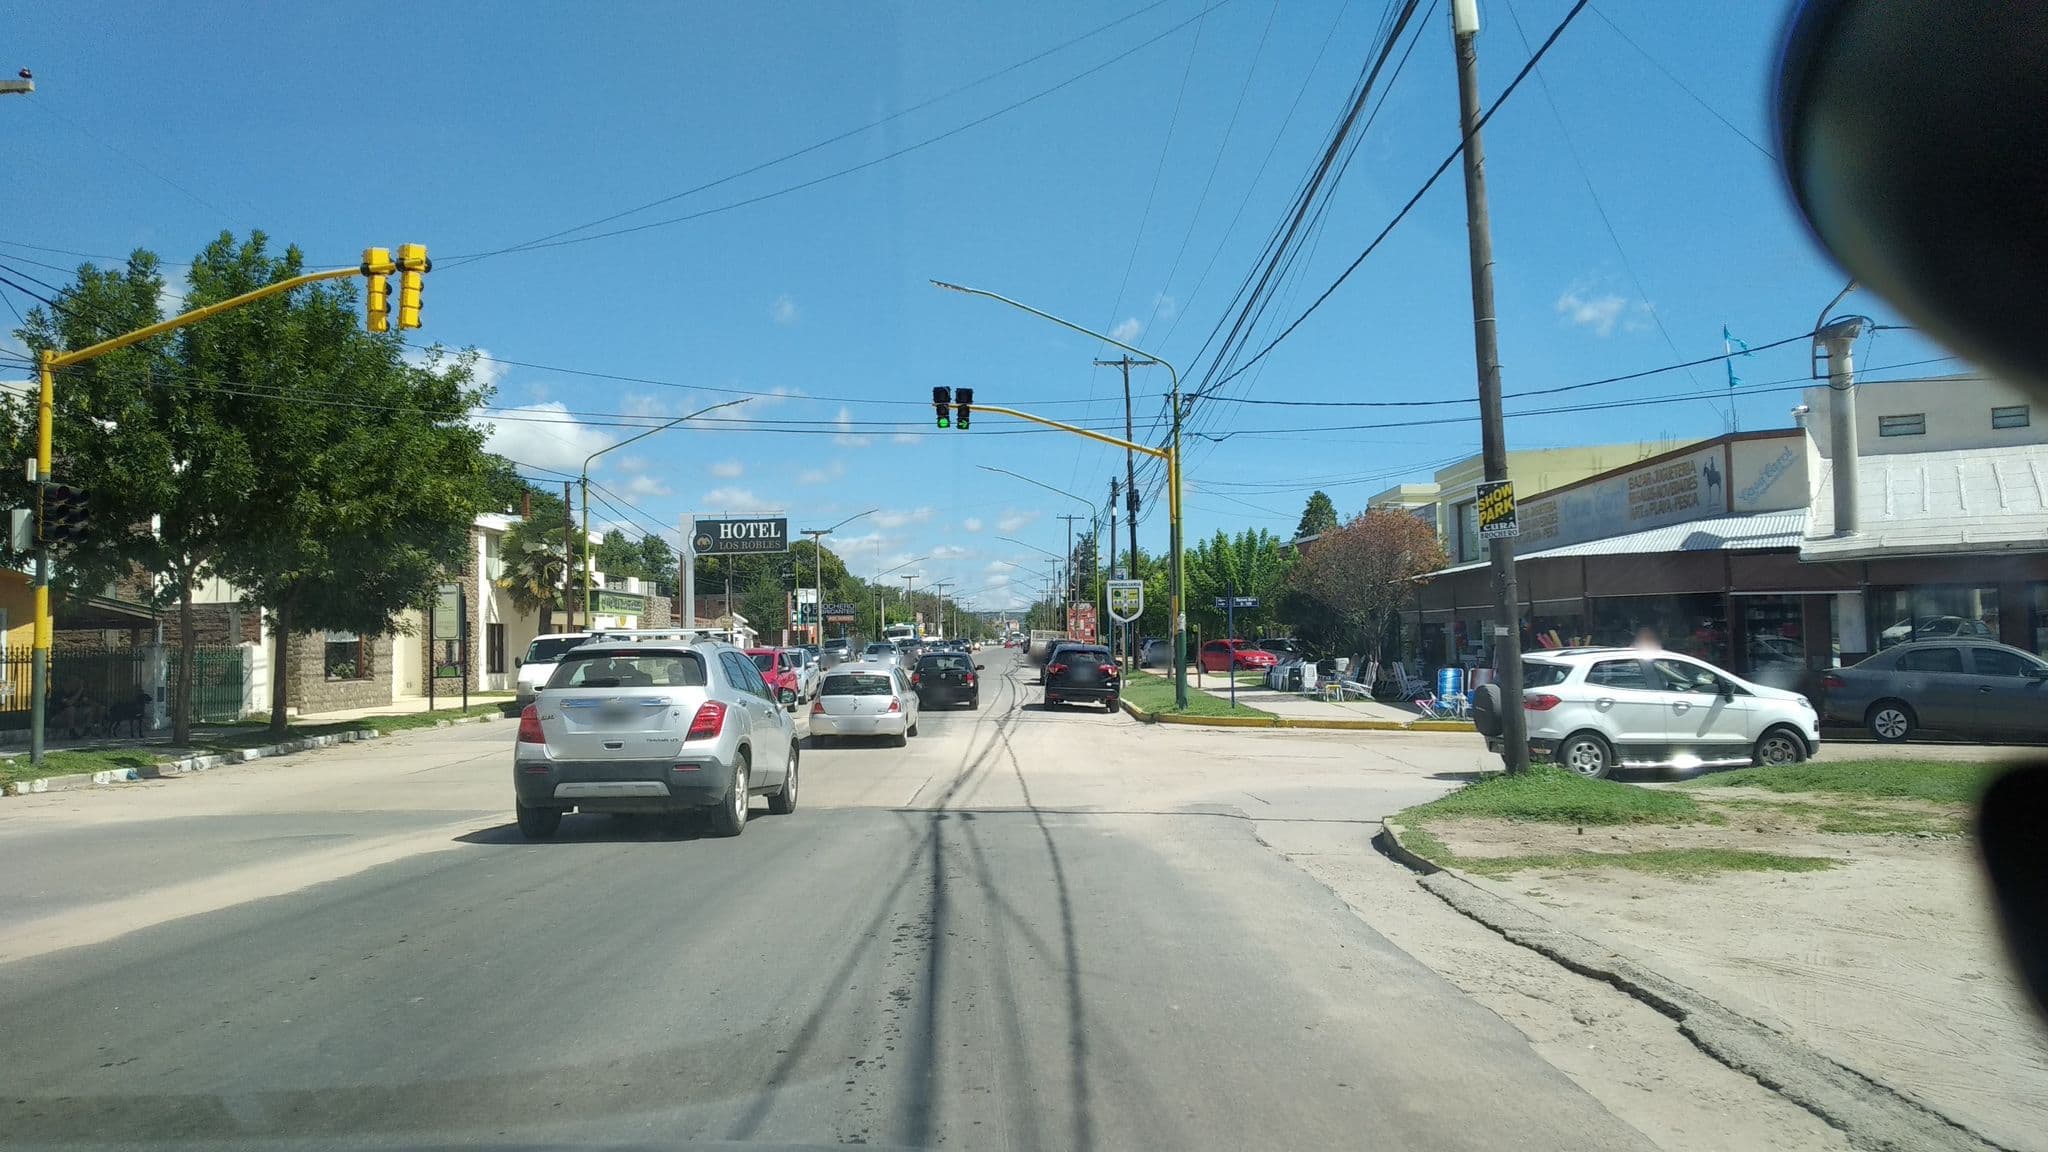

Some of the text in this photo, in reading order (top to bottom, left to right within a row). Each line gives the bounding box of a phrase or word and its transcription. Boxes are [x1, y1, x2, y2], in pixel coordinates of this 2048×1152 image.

[1478, 482, 1513, 511] SHOW
[1479, 497, 1514, 527] PARK
[720, 522, 780, 539] HOTEL
[1483, 521, 1516, 531] CURA
[720, 540, 781, 550] LOS ROBLES
